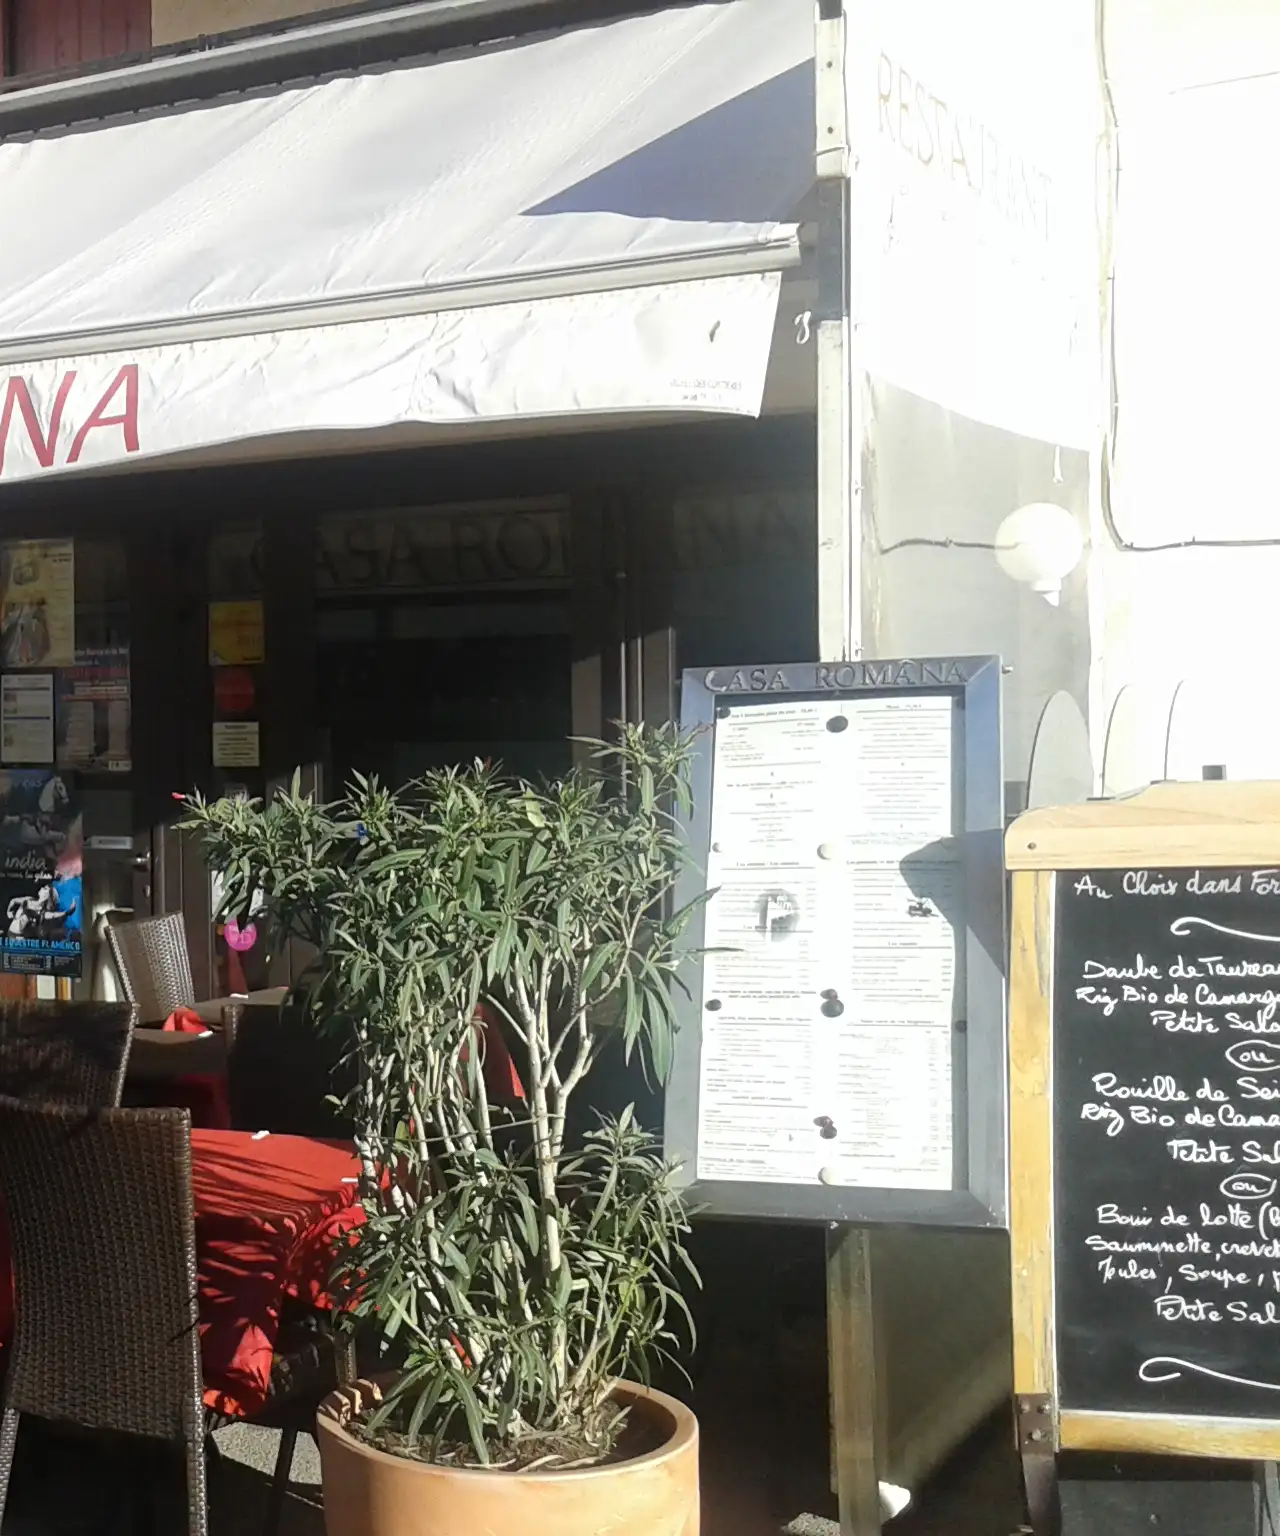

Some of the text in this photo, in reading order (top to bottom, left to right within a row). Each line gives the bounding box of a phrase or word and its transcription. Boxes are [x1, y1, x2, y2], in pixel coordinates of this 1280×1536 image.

[704, 660, 969, 692] CASA ROMANA
[1074, 874, 1113, 899] Au
[1122, 870, 1179, 896] Choix
[1186, 870, 1242, 895] dans
[1082, 953, 1163, 979] Daube
[1169, 955, 1205, 978] de
[1122, 985, 1158, 1004] Bio
[1164, 983, 1189, 1004] de
[1150, 1009, 1220, 1033] Petite
[1239, 1050, 1275, 1063] ou
[1092, 1072, 1190, 1101] Rouille
[1196, 1077, 1229, 1101] de
[1129, 1105, 1175, 1127] Bio
[1185, 1106, 1216, 1127] de
[1167, 1139, 1235, 1163] Petite
[1231, 1181, 1268, 1194] ou
[1160, 1205, 1191, 1226] de
[1154, 1295, 1223, 1322] Petite
